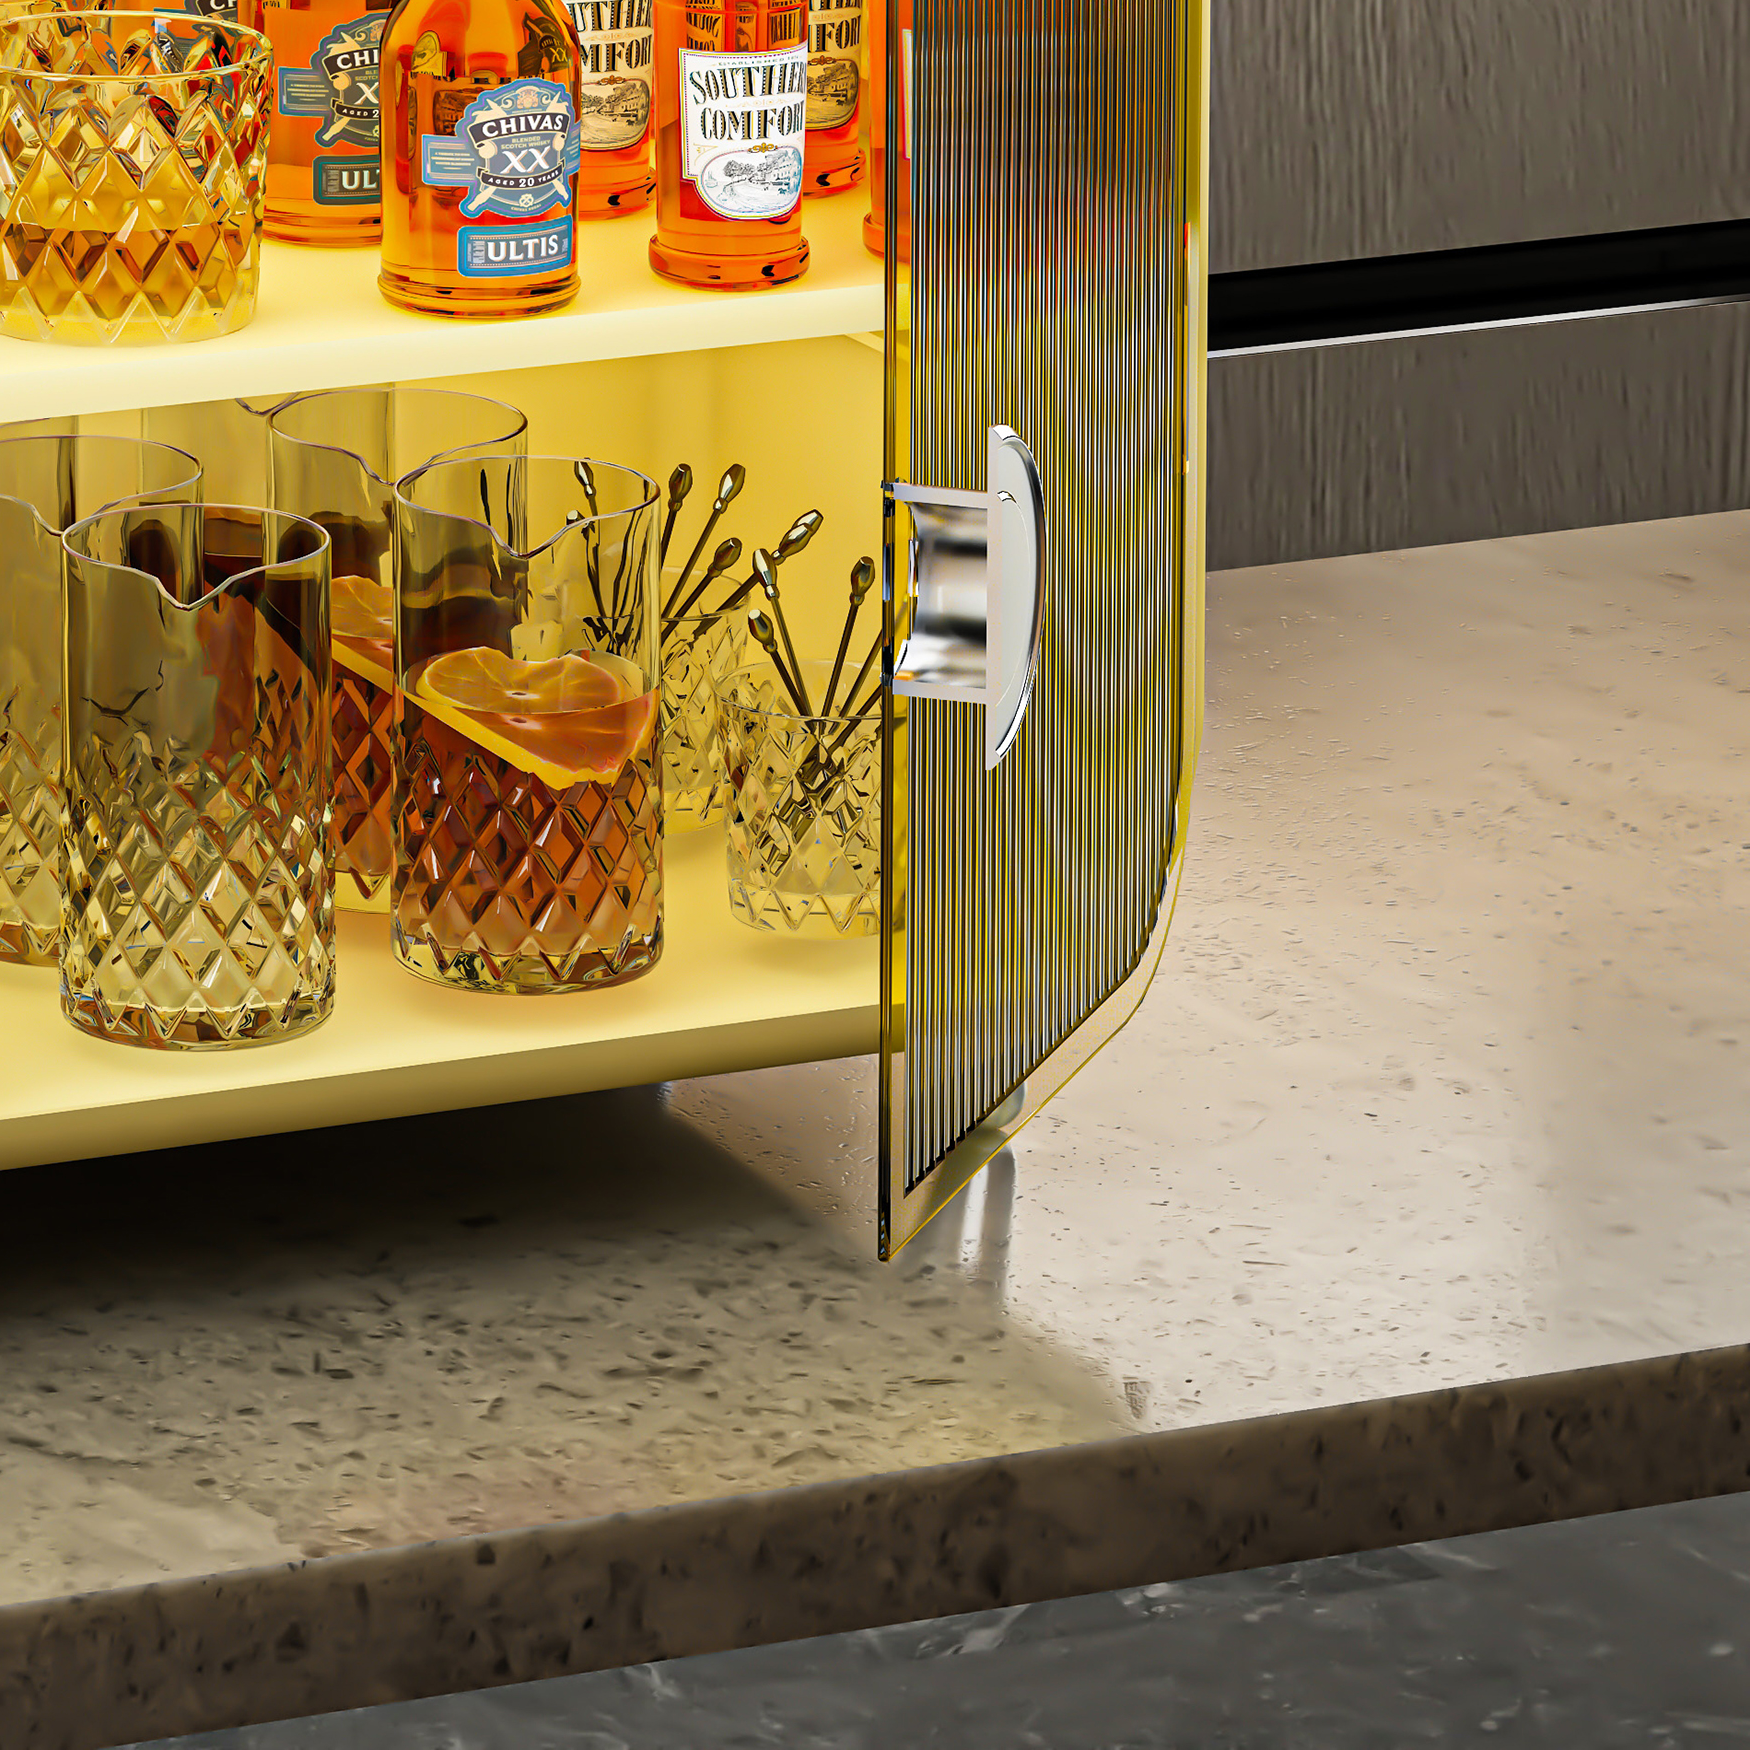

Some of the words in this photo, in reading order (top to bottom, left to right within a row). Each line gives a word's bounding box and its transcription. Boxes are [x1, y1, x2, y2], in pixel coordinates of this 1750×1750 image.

[343, 109, 368, 117] AGED
[482, 115, 563, 138] CHIVAS
[500, 146, 550, 174] XX
[488, 177, 515, 186] AGED
[519, 178, 535, 188] 20
[538, 170, 559, 182] YEARS
[487, 235, 559, 262] ULTIS
